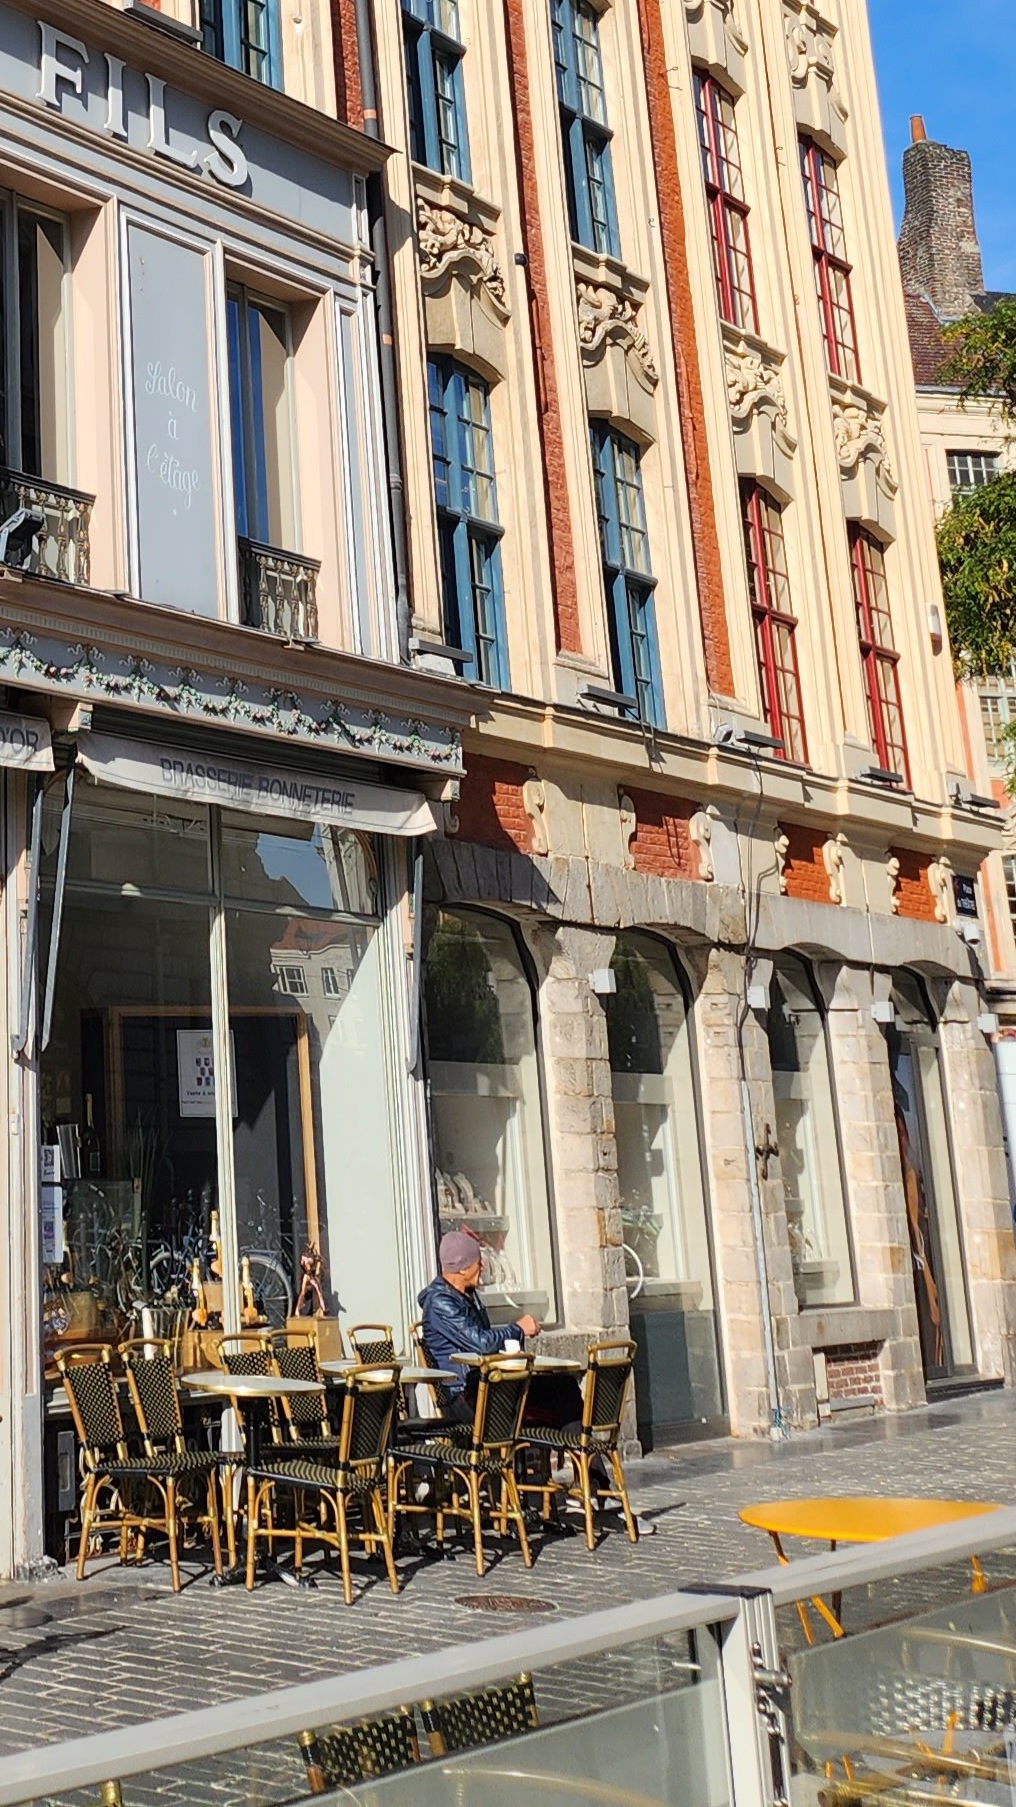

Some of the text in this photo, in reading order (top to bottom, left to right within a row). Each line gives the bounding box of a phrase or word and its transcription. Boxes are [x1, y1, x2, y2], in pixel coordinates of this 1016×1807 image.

[35, 20, 249, 187] FILS
[144, 360, 198, 413] Salon
[167, 411, 179, 441] à
[159, 757, 356, 815] BRASSERIE BONNETERIE
